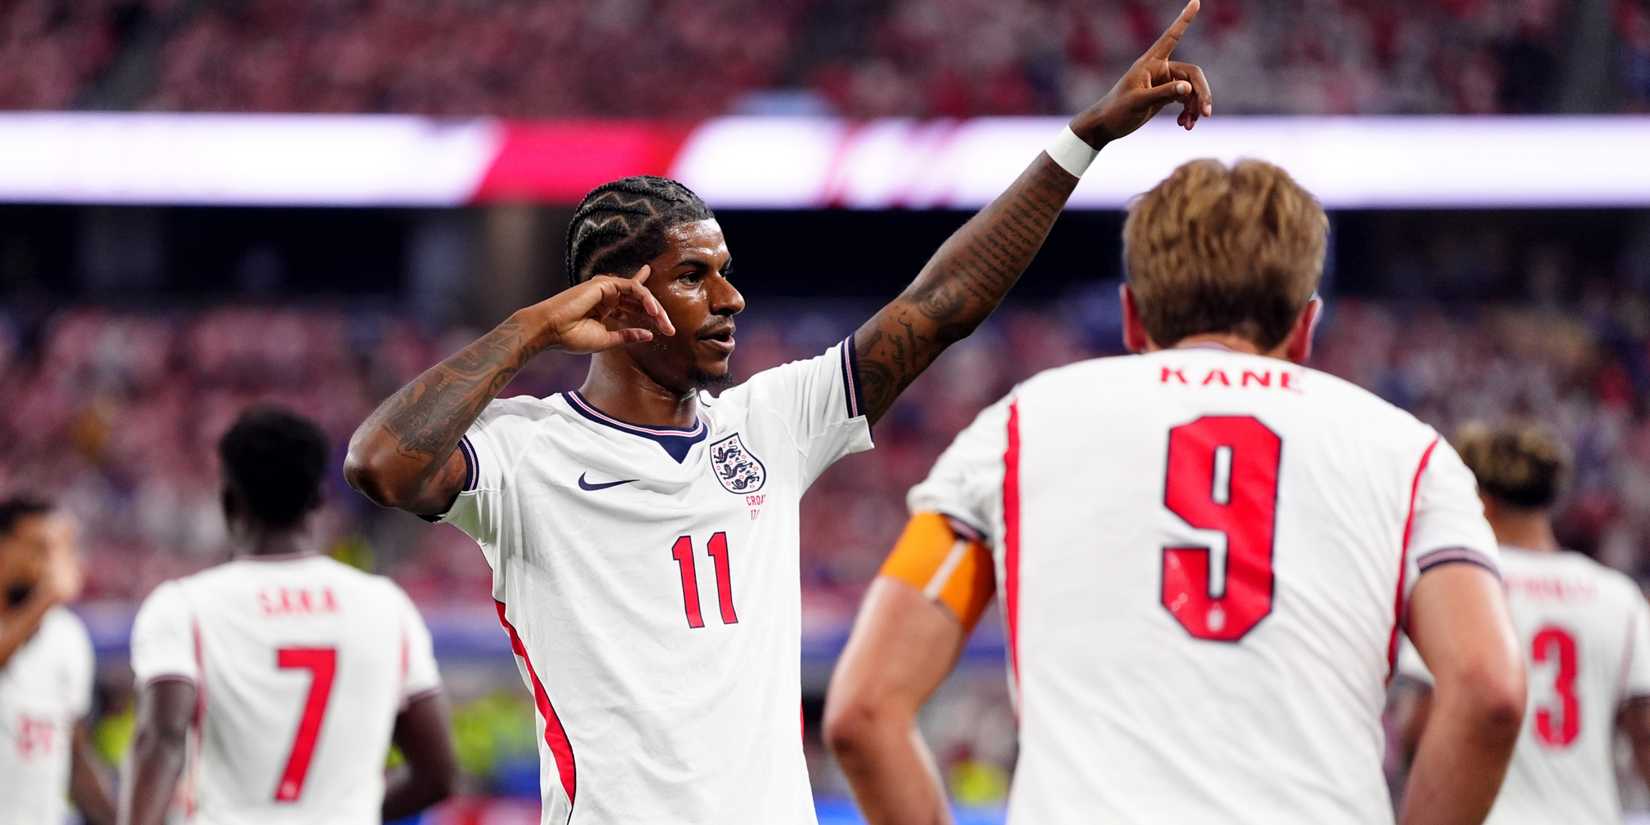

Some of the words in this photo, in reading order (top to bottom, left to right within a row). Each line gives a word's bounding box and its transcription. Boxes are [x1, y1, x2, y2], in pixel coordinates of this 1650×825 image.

[1161, 366, 1302, 394] KANE
[671, 531, 739, 629] 11
[1161, 415, 1282, 643] 9
[275, 647, 338, 802] 7
[1532, 625, 1580, 749] 3
